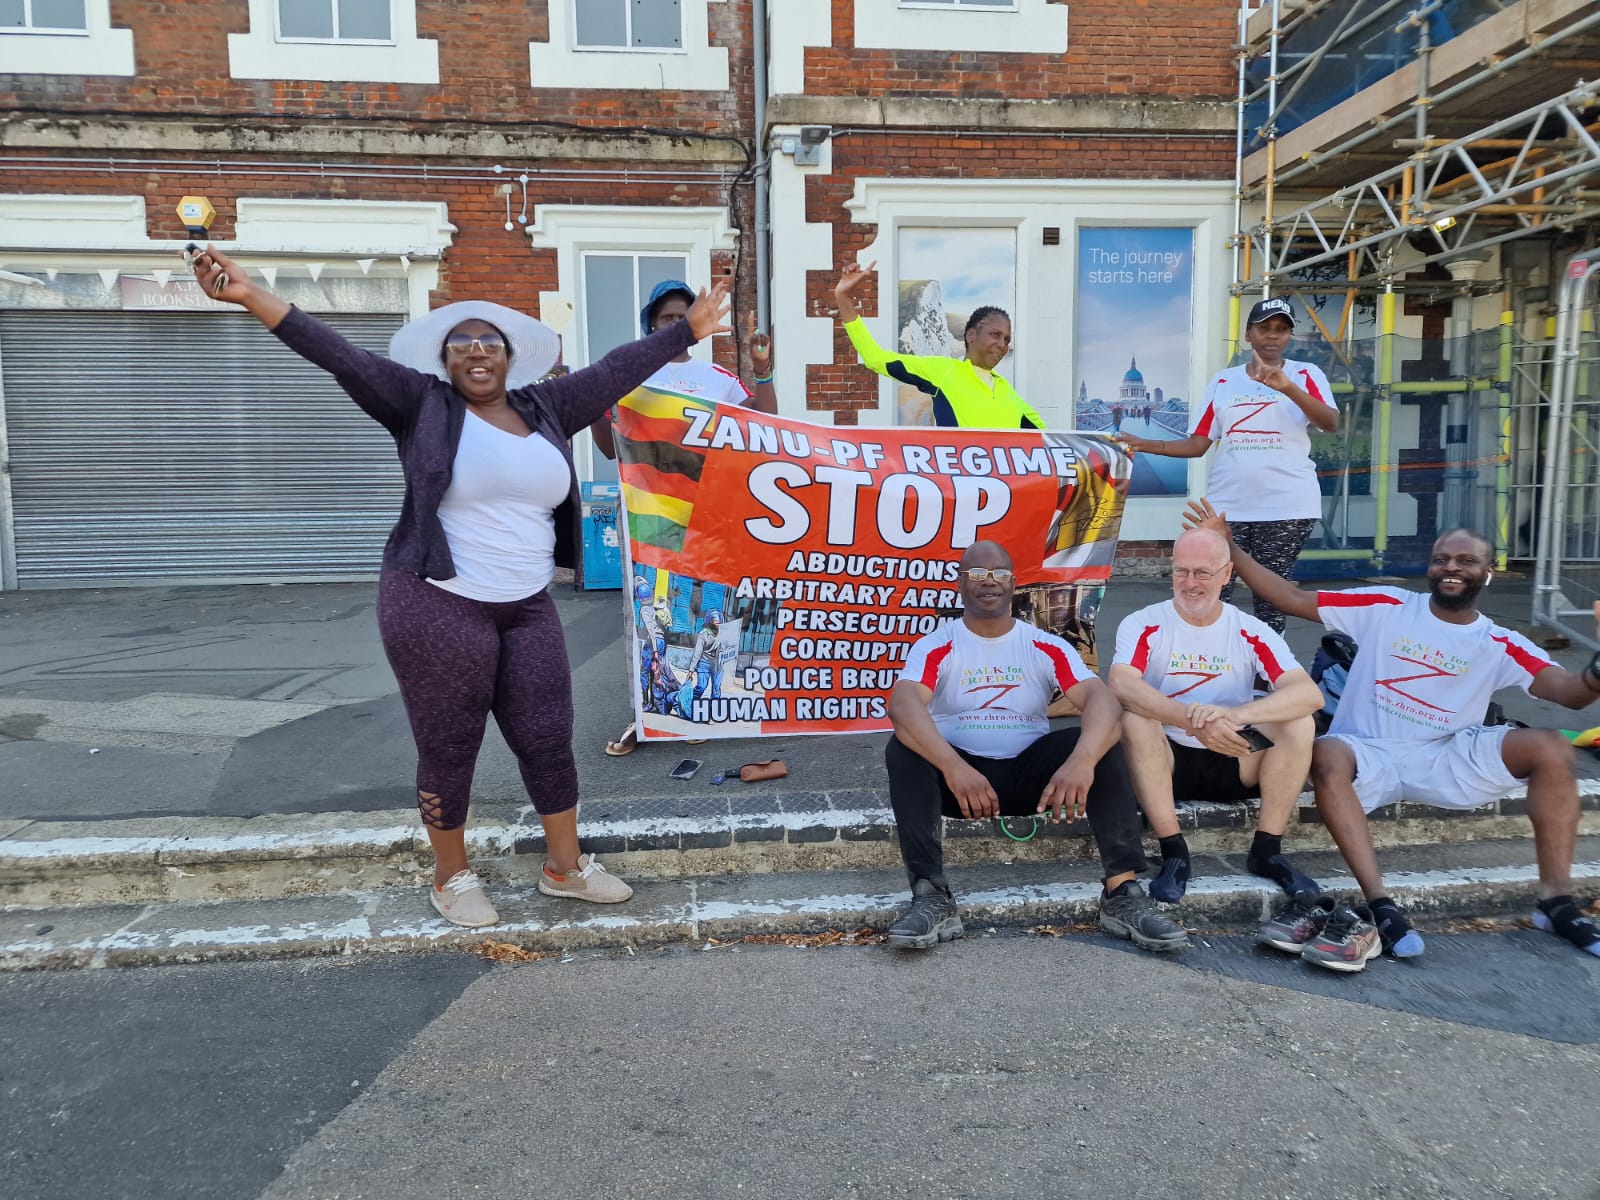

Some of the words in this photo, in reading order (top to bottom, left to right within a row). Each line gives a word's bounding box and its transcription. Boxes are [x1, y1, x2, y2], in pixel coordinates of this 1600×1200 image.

[1088, 248, 1120, 265] The
[1122, 248, 1183, 268] journey
[1088, 268, 1134, 284] starts
[1138, 267, 1173, 284] here
[681, 407, 886, 470] ZANU-PF
[901, 444, 1077, 477] REGIME
[744, 460, 1012, 550] STOP
[786, 551, 960, 582] ABDUCTIONS
[735, 576, 896, 606] ARBITRARY
[743, 667, 833, 690] POLICE
[691, 697, 787, 722] HUMAN
[796, 696, 888, 720] RIGHTS
